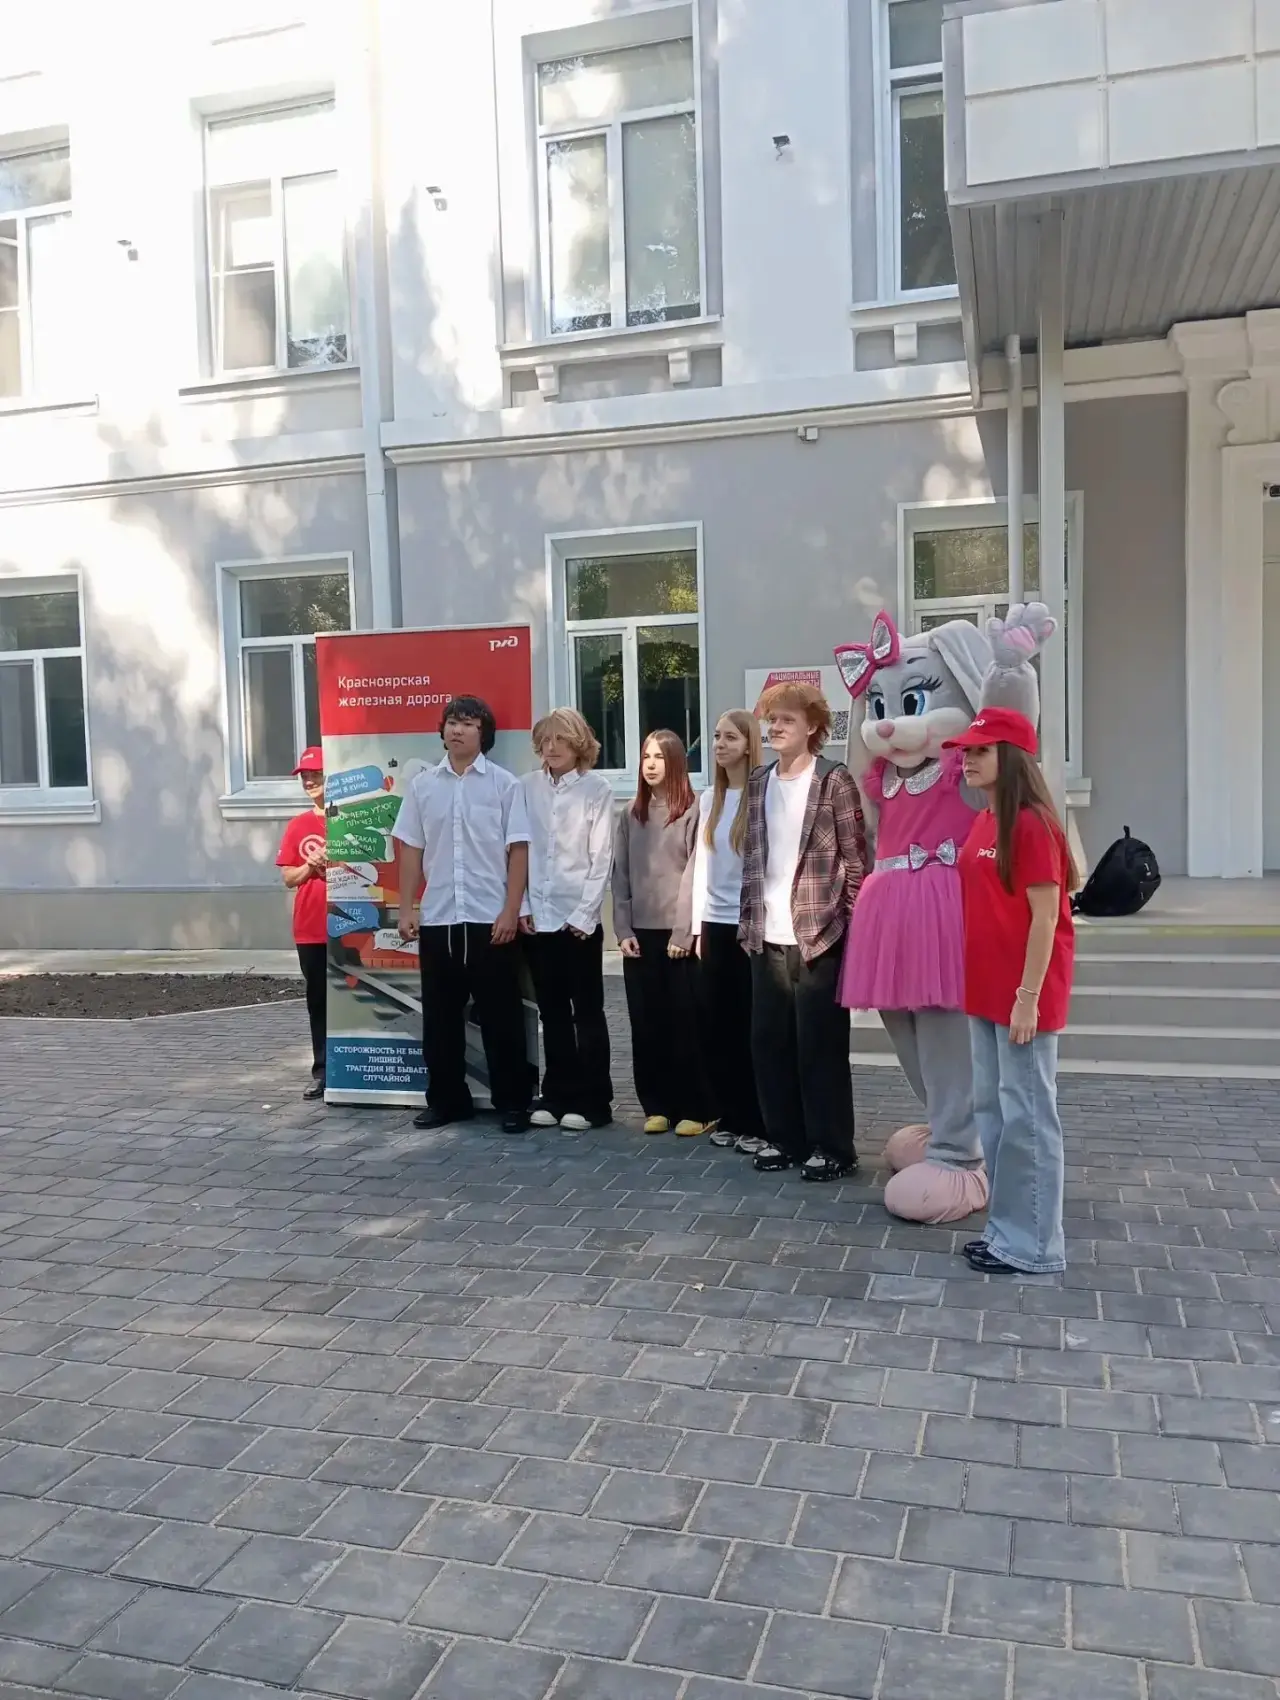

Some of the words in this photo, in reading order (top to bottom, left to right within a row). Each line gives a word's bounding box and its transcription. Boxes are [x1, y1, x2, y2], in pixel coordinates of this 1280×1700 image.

[338, 675, 430, 689] Красноярская
[338, 695, 402, 707] железная
[406, 693, 452, 706] дорога
[340, 774, 366, 785] ЗАВТРА
[349, 781, 369, 791] КИНО
[354, 834, 378, 844] ТАКАЯ
[333, 1046, 395, 1055] ОСТОРОЖНОСТЬ
[396, 1047, 407, 1055] НЕ
[368, 1055, 405, 1064] ЛИШНЕЙ,
[345, 1064, 384, 1073] ТРАГЕДИЯ
[385, 1065, 396, 1073] НЕ
[397, 1066, 429, 1074] БЫВАЕТ
[362, 1074, 411, 1083] СЛУЧАЙНОЙ
